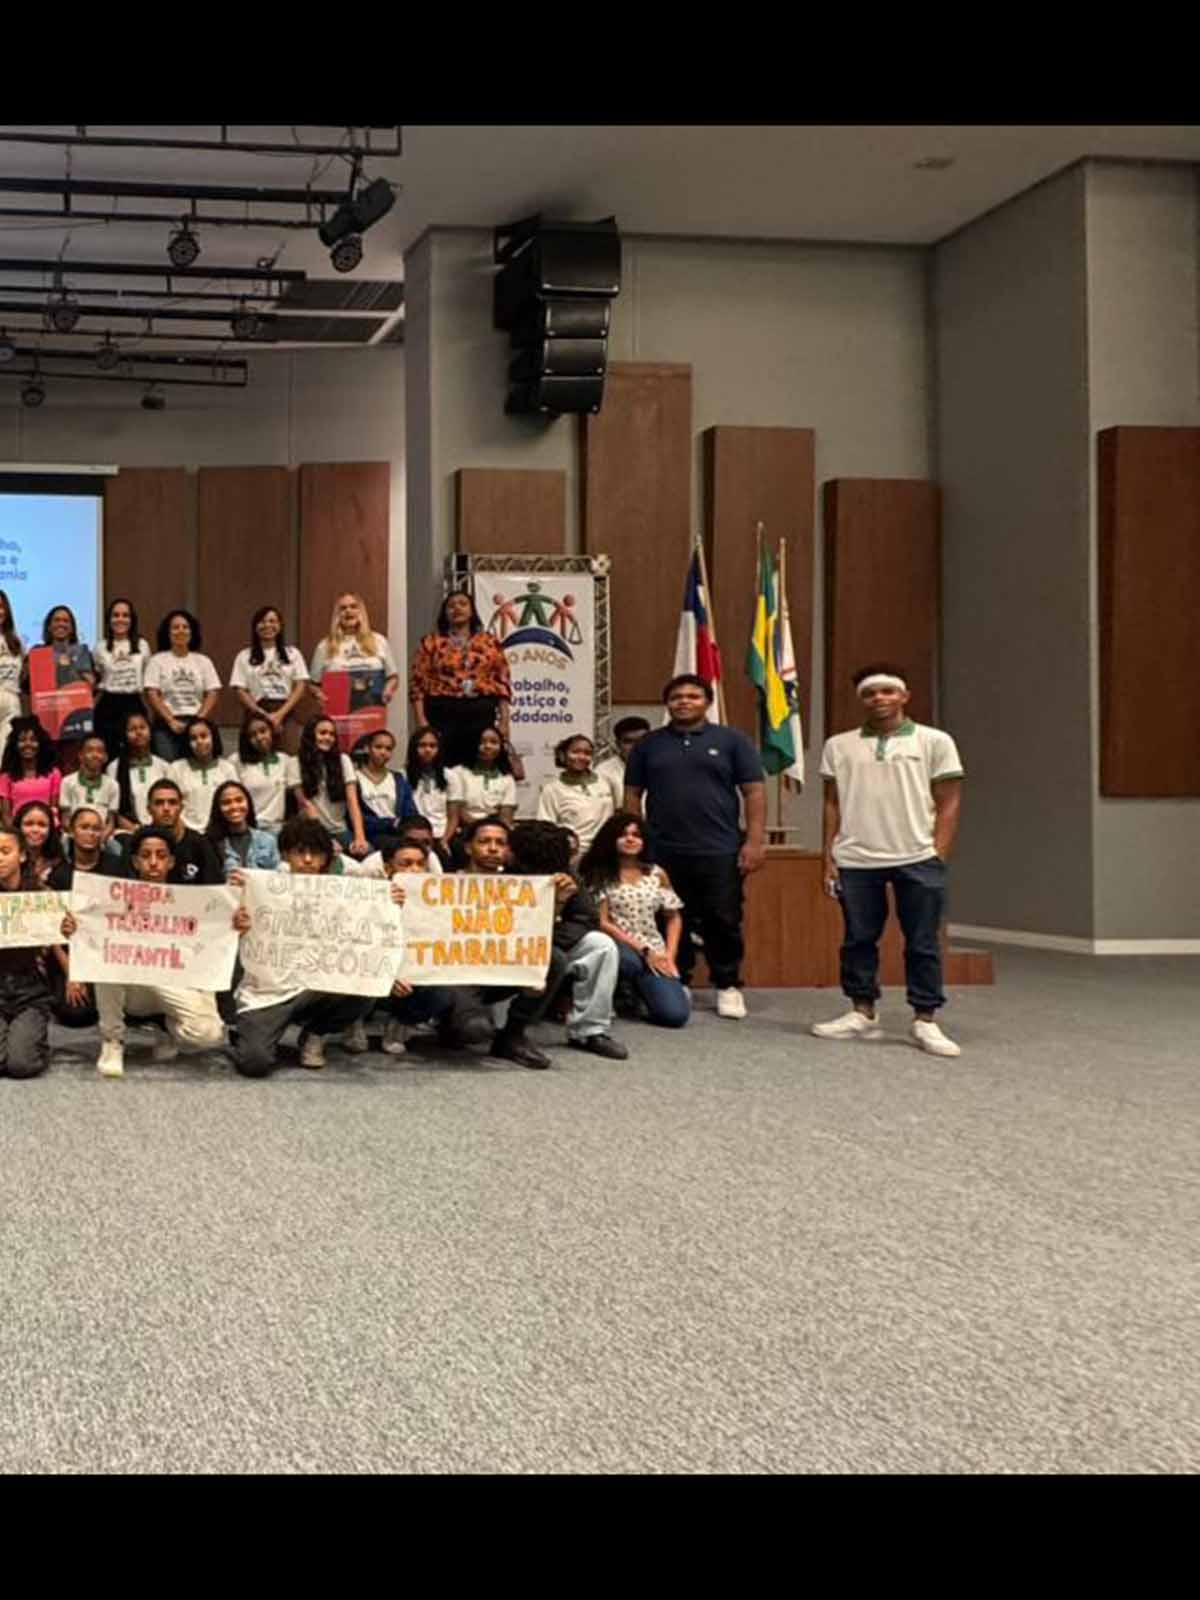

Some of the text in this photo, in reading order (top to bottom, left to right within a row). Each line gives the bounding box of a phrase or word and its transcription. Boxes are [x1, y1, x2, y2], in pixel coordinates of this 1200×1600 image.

[10, 555, 18, 565] e
[522, 649, 568, 670] ANOS
[512, 678, 570, 693] abalho,
[560, 697, 569, 707] e
[511, 711, 573, 722] dadania
